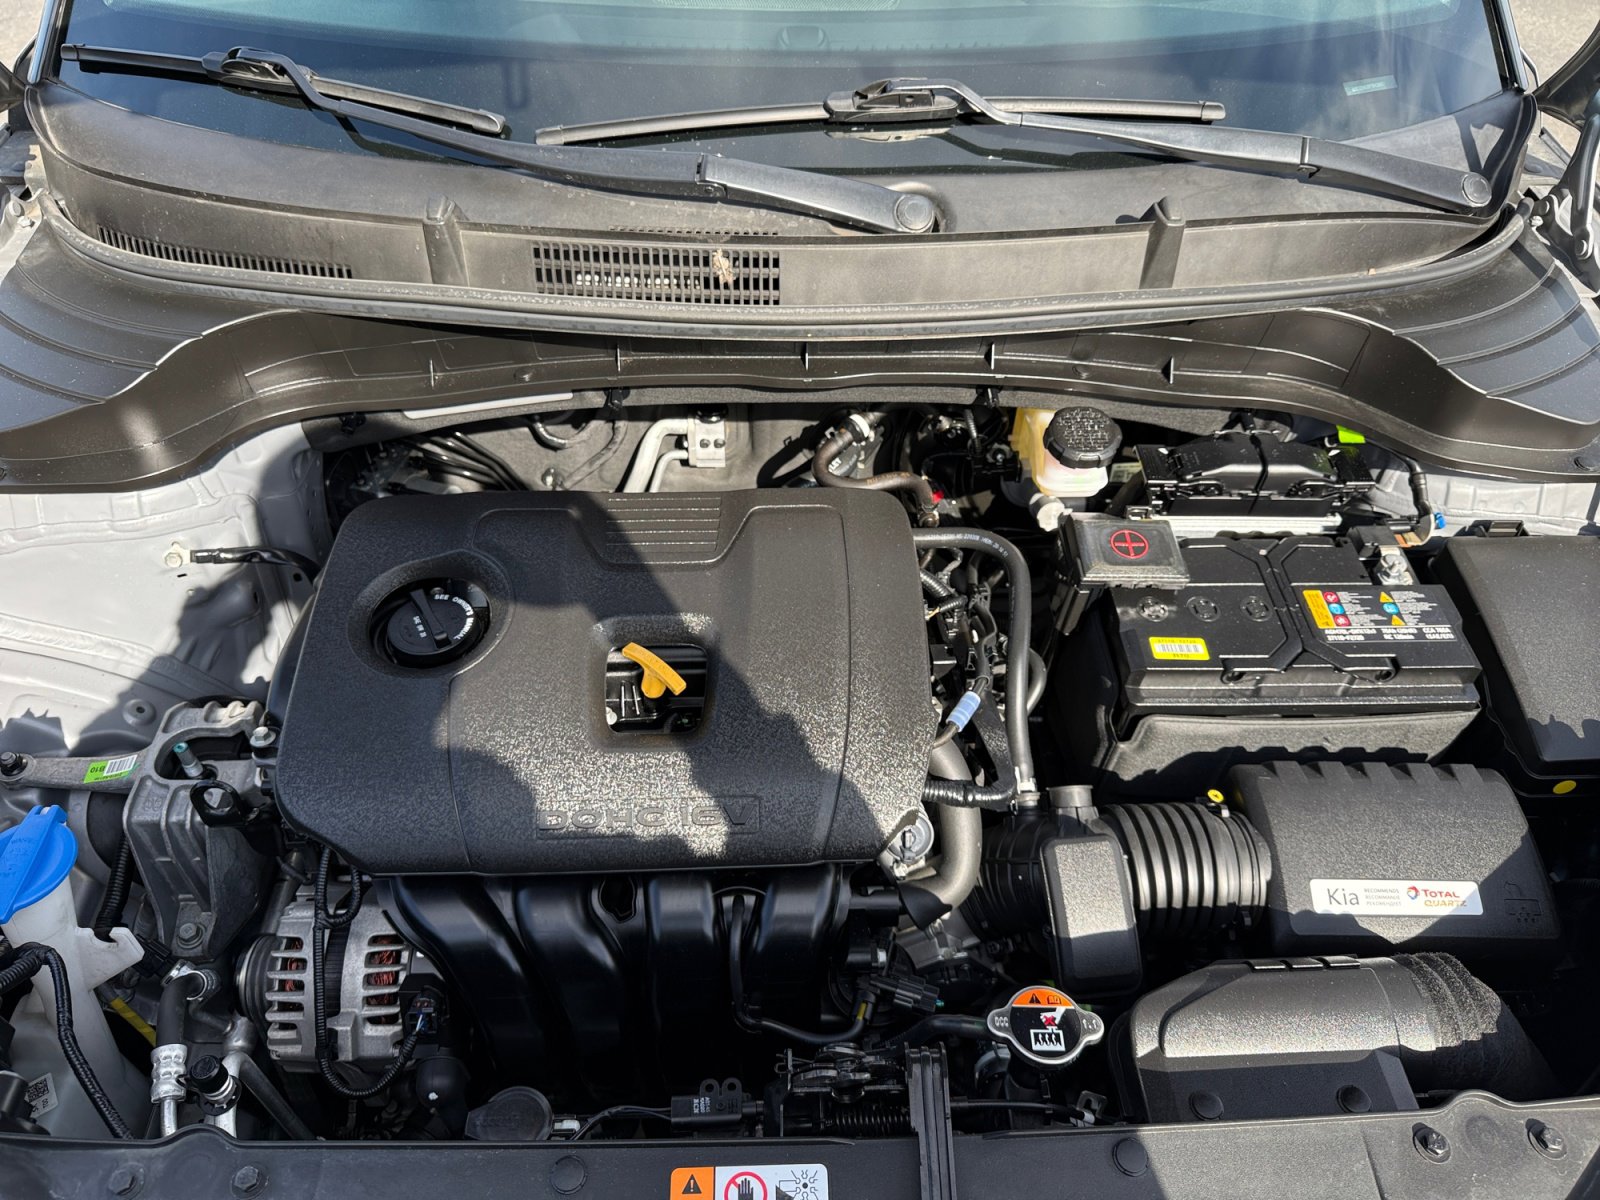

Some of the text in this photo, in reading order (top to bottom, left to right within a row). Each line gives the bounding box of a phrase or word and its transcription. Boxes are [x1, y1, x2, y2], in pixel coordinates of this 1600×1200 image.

[453, 617, 474, 640] MANUAL
[539, 804, 754, 830] DOHC 16V
[1326, 887, 1360, 906] Kia
[1422, 889, 1460, 899] TOTAL
